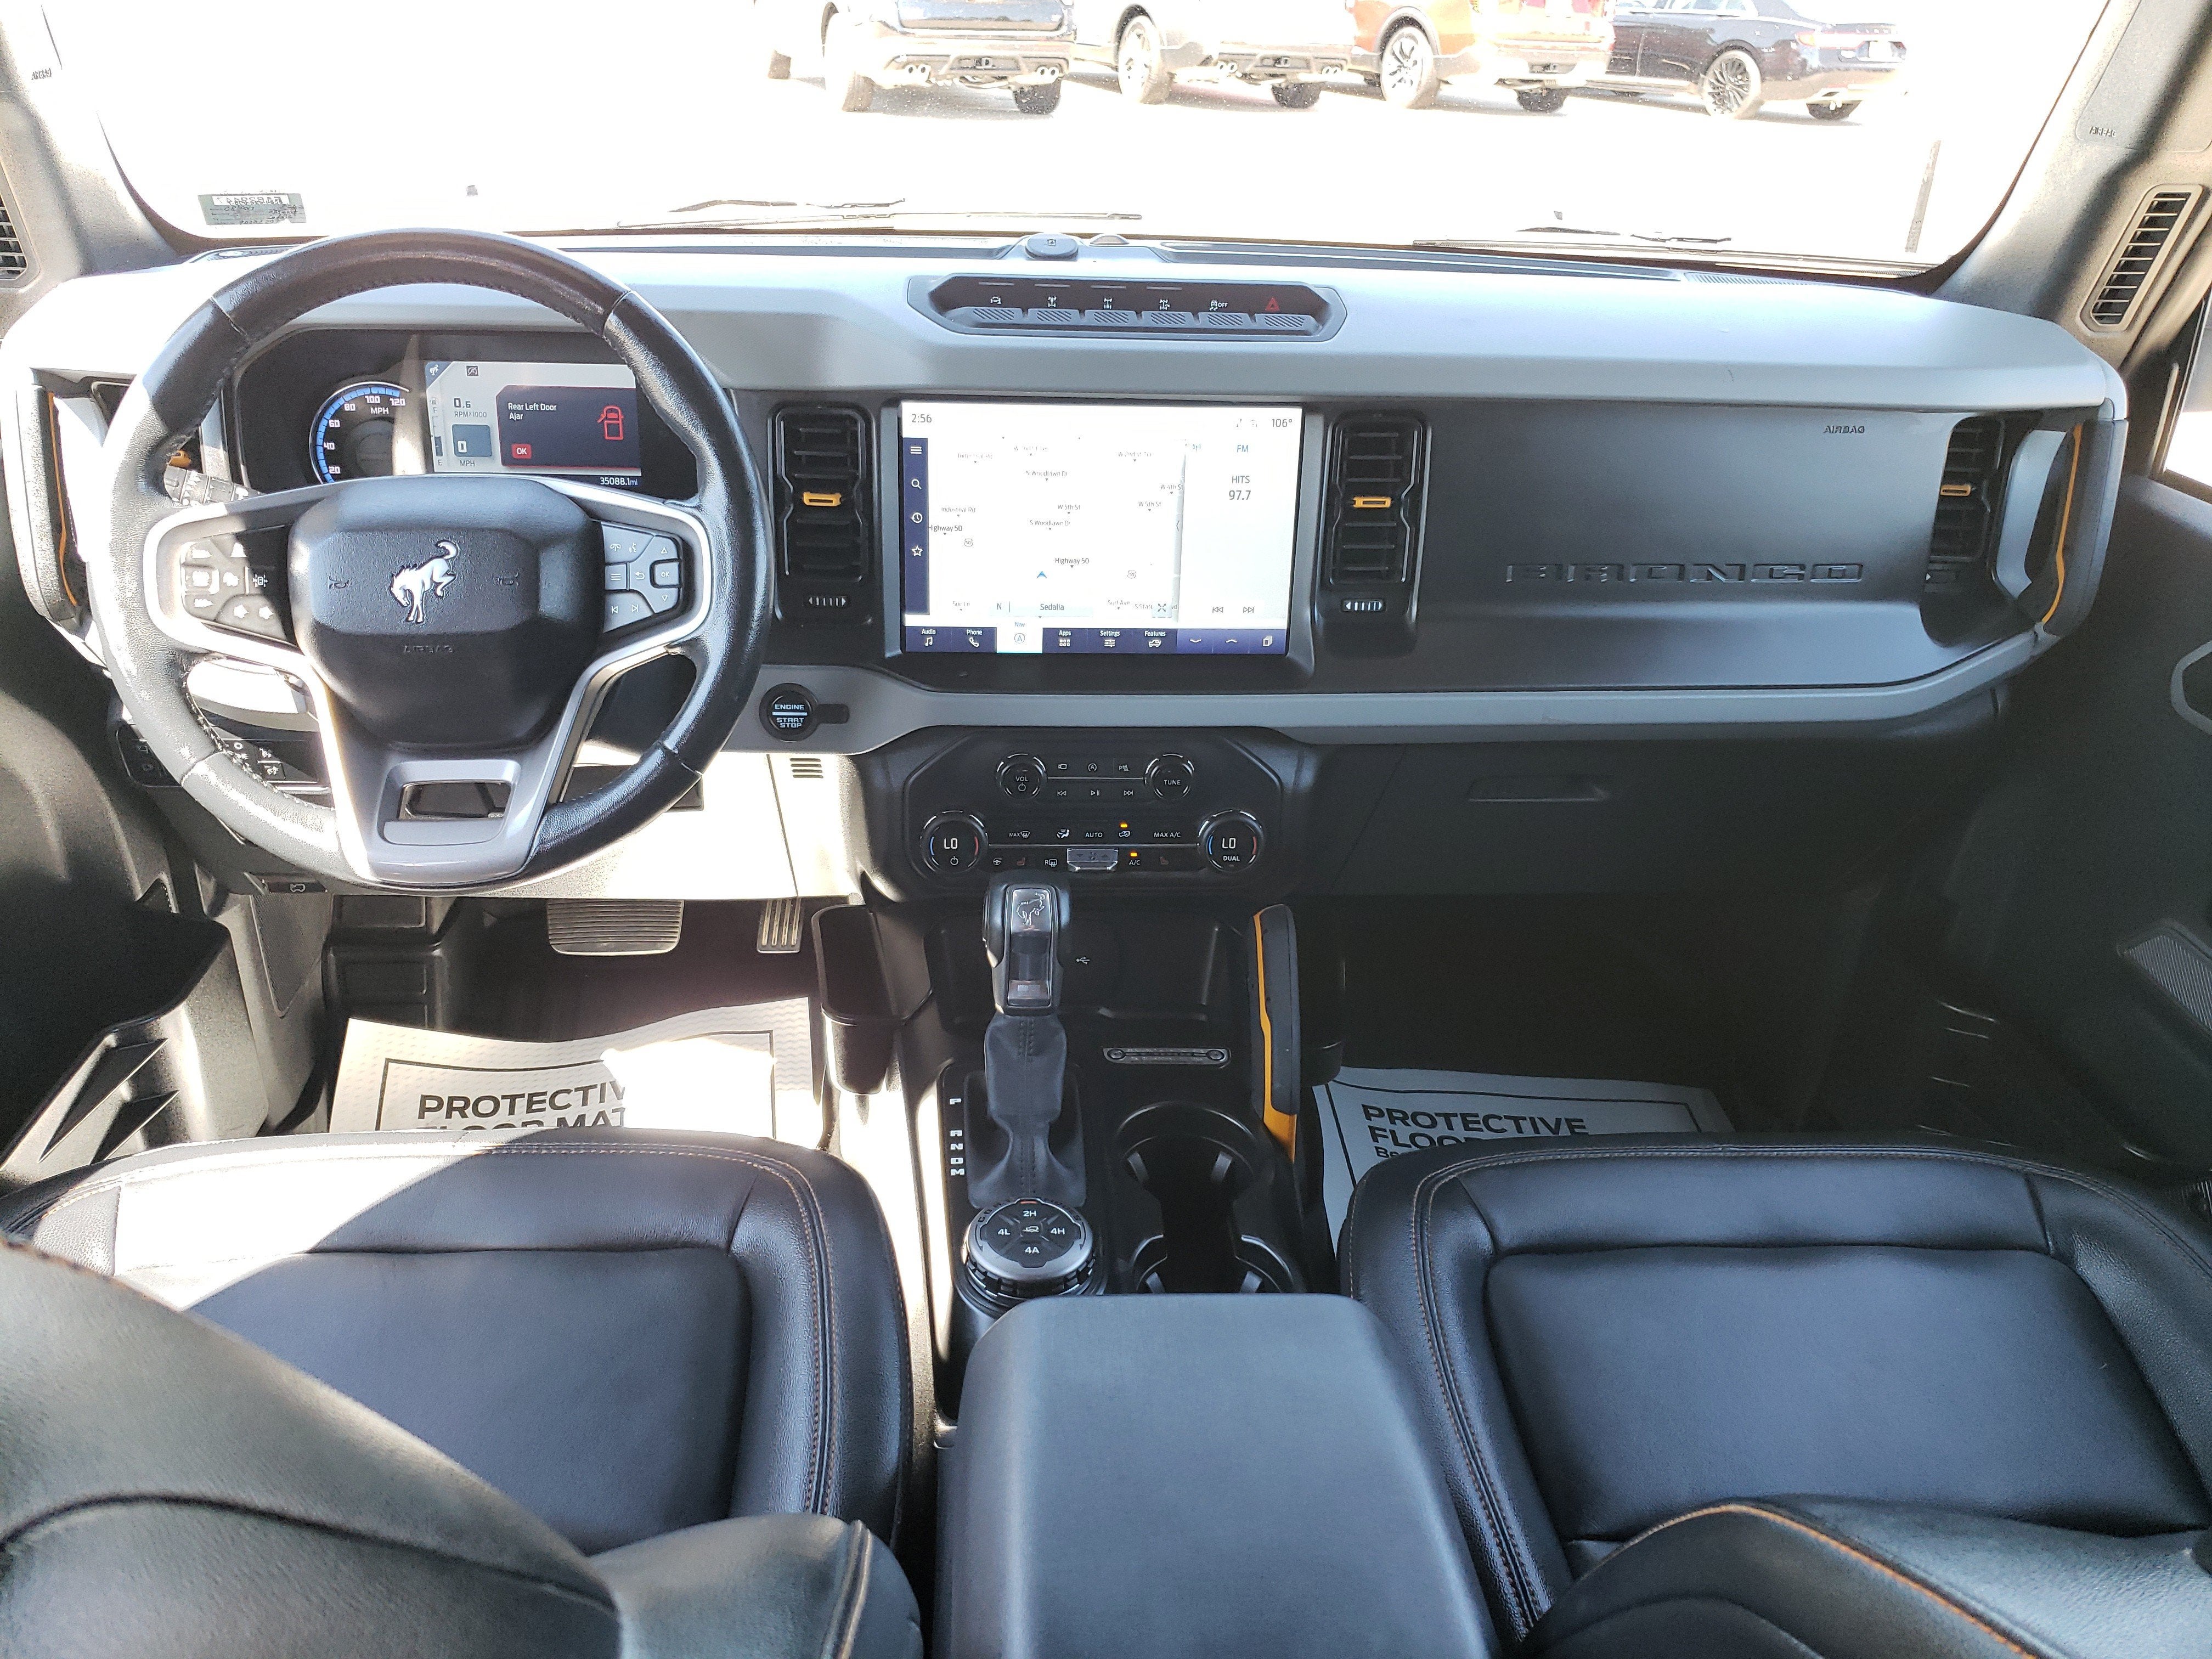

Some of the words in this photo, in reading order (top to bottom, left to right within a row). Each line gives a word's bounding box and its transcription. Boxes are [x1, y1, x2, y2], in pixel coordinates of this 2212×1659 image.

[365, 396, 381, 404] 100
[390, 398, 405, 407] 120
[453, 398, 471, 409] 0.6
[344, 403, 356, 411] 80
[509, 413, 523, 421] Ajar
[911, 414, 932, 423] 2:56
[329, 420, 341, 428] 60
[1272, 419, 1293, 427] 106°
[1822, 425, 1865, 435] AIRBAG
[323, 442, 335, 450] 40
[1237, 444, 1249, 453] FM
[329, 466, 341, 475] 20
[1232, 475, 1250, 484] HITS
[1229, 490, 1251, 500] 97.7
[1505, 563, 1864, 583] BRONCO
[944, 838, 958, 849] LO
[1222, 838, 1236, 849] LO
[417, 1080, 625, 1119] PROTECTIV
[1362, 1104, 1589, 1136] PROTECTIVE
